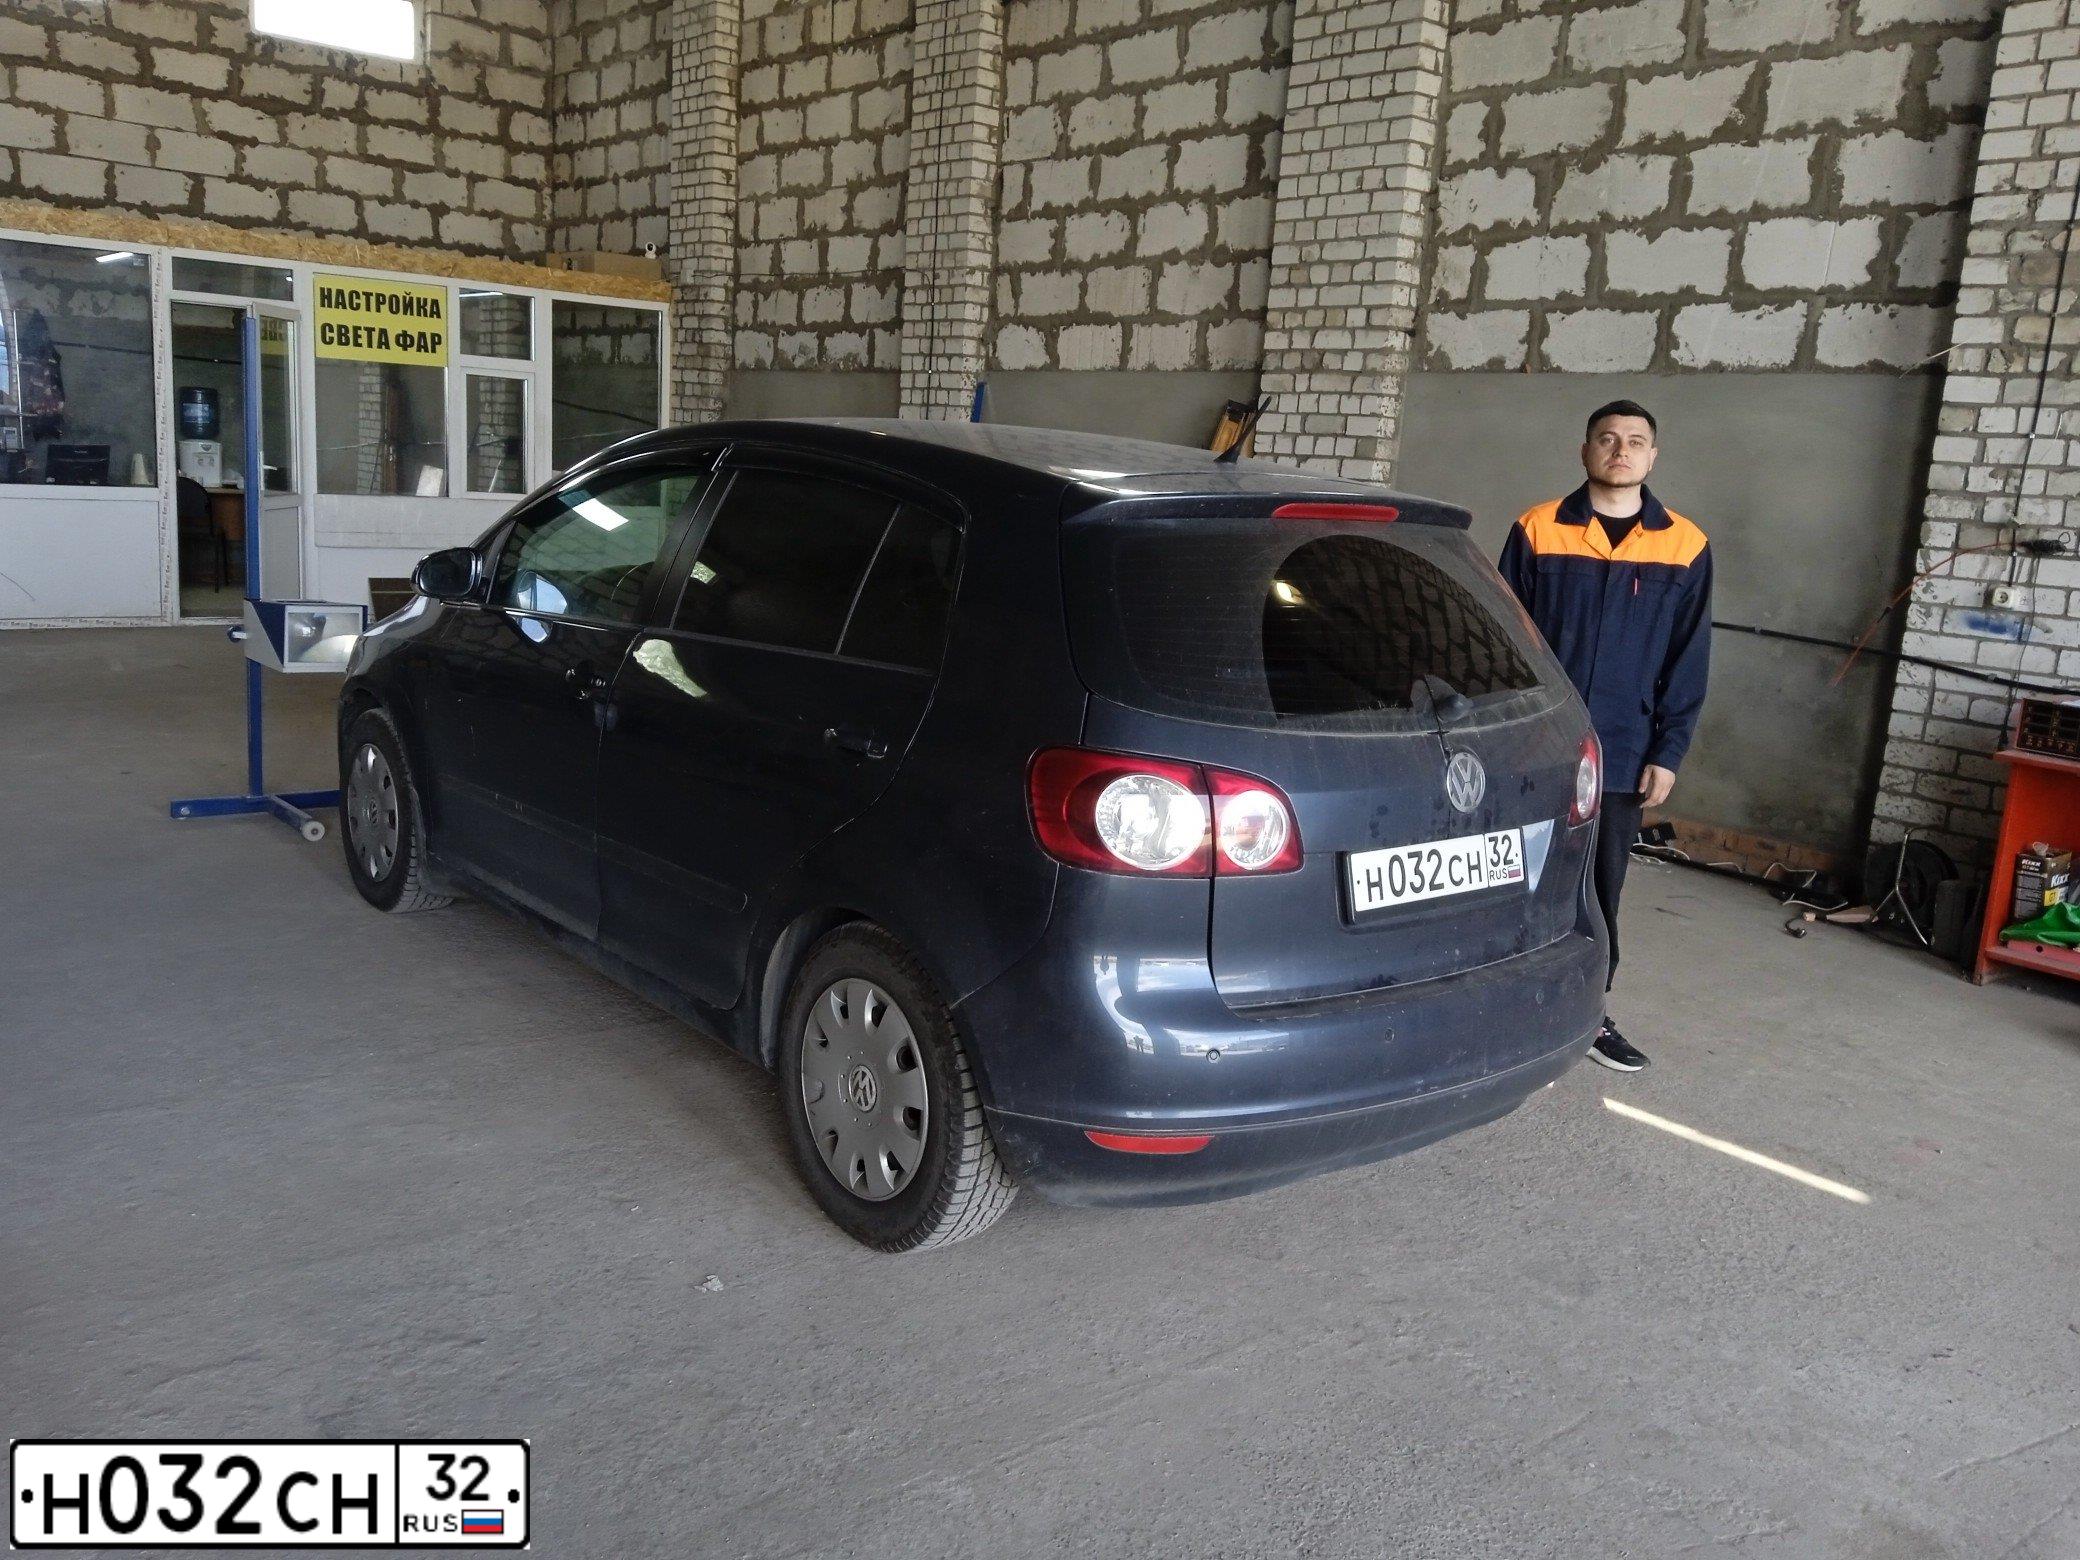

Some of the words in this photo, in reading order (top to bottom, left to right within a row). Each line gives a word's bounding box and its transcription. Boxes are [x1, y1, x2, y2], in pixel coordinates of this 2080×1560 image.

[319, 286, 442, 320] НАСТРОЙКА
[320, 322, 391, 350] СВЕТА
[394, 329, 442, 354] ФАР
[1366, 848, 1482, 903] Н032СН
[1488, 834, 1514, 868] 32
[1489, 867, 1508, 881] RUS
